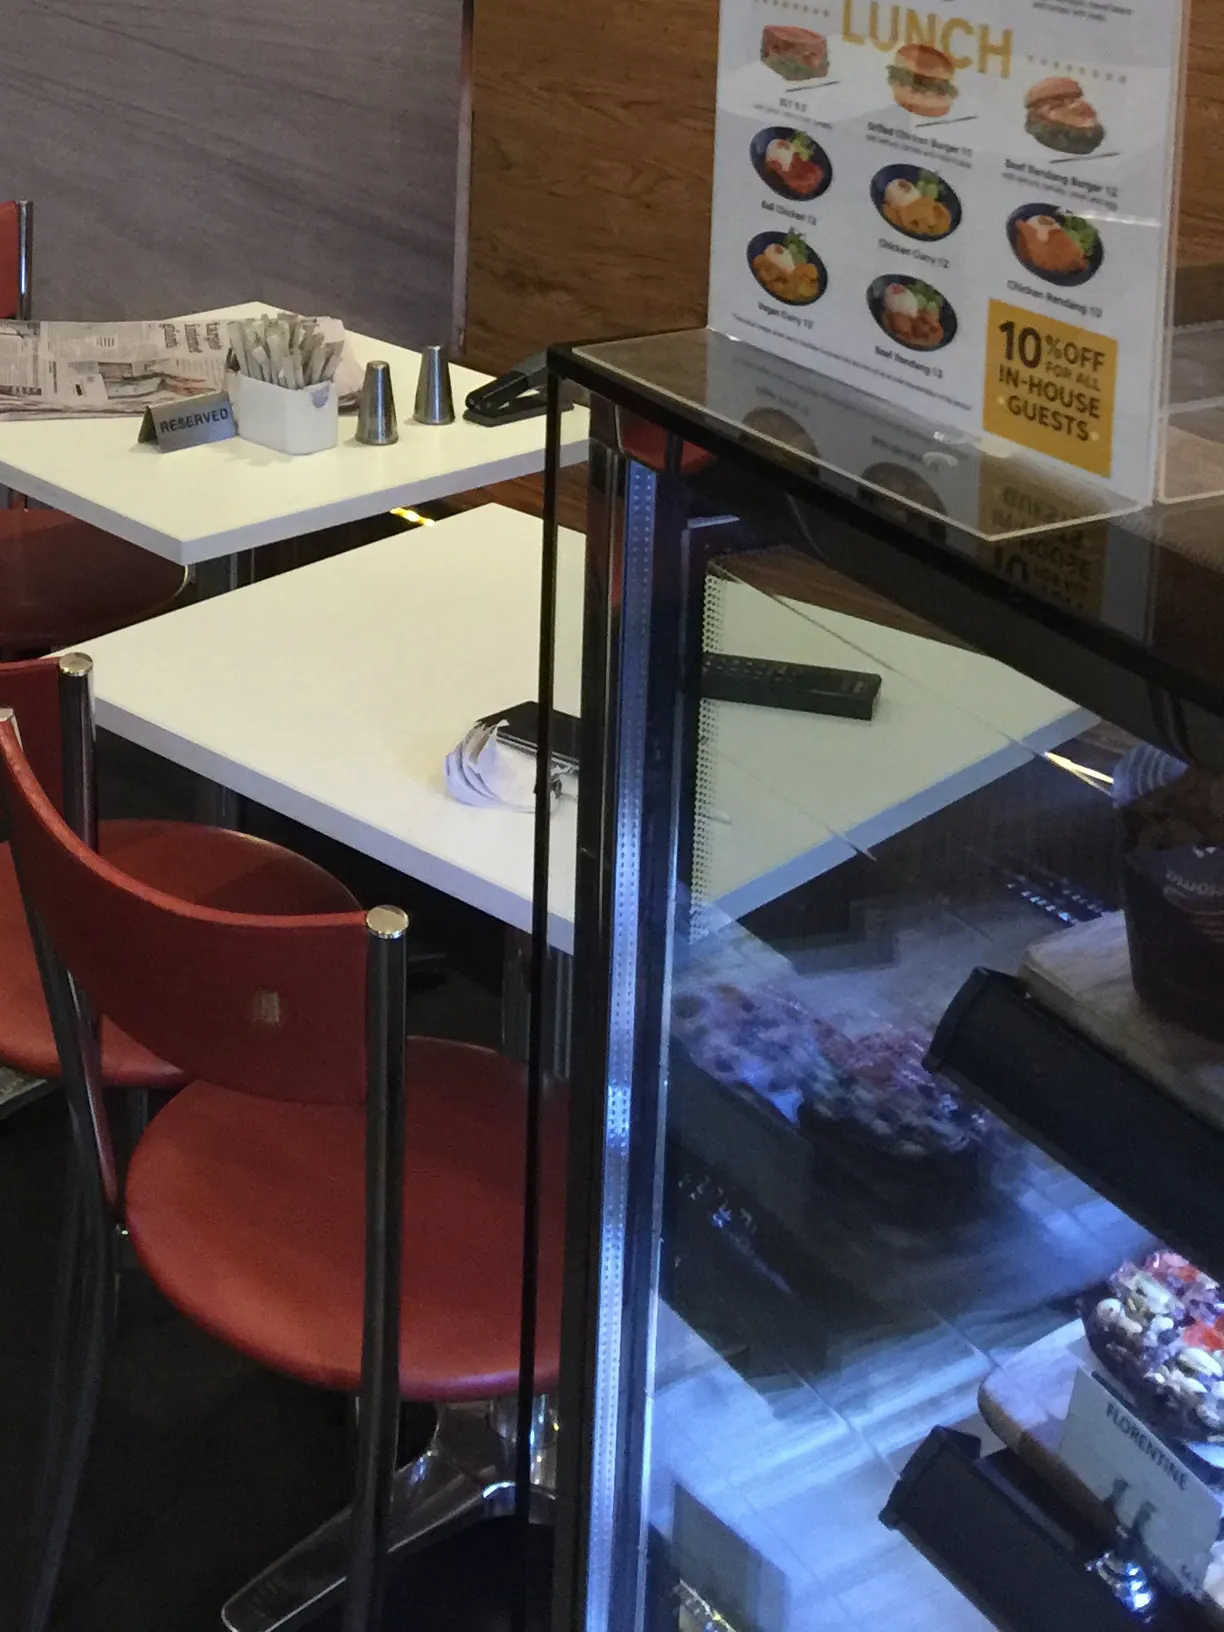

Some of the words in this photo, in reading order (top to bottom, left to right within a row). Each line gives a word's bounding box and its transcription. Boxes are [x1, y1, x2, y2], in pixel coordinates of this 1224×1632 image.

[999, 365, 1101, 419] IN-HOUSE
[159, 407, 229, 434] RESERVED
[1007, 395, 1090, 442] GUESTS
[1106, 1401, 1189, 1491] FLORENTINE
